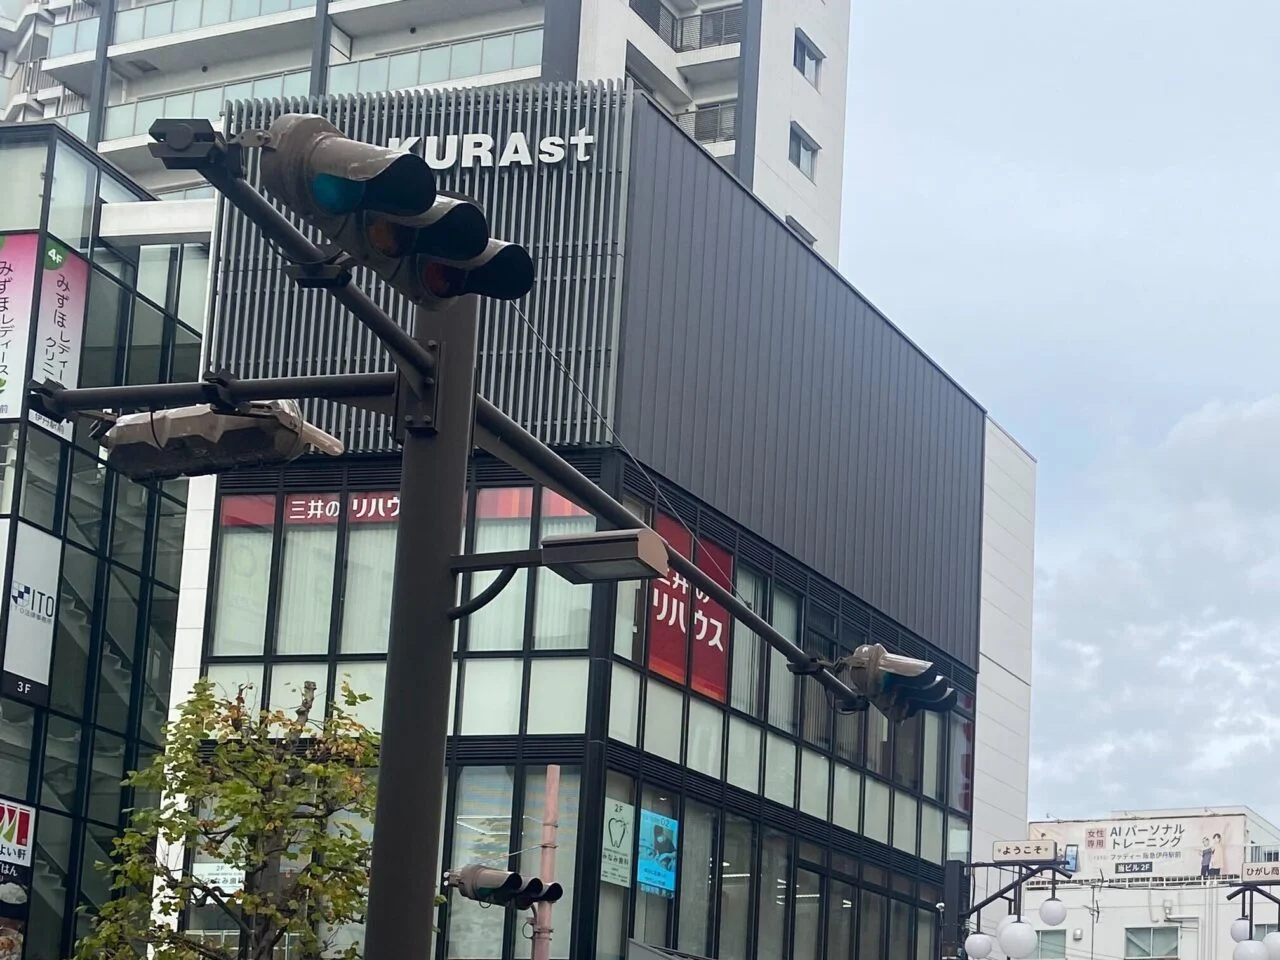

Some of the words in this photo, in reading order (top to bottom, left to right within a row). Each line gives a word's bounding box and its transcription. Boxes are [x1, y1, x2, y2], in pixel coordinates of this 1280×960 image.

[48, 247, 63, 264] 4F
[54, 273, 71, 381] みずほレディー
[42, 336, 57, 377] クリニ
[290, 496, 400, 519] 三井のリハウ
[31, 589, 55, 617] ITO
[652, 587, 724, 652] リハウス
[17, 681, 31, 694] 3F
[1087, 830, 1105, 838] 女性
[1125, 824, 1185, 837] パーソナル
[1112, 836, 1183, 849] トレーニング
[1001, 845, 1042, 856] ようこそ
[1140, 863, 1151, 871] 2F
